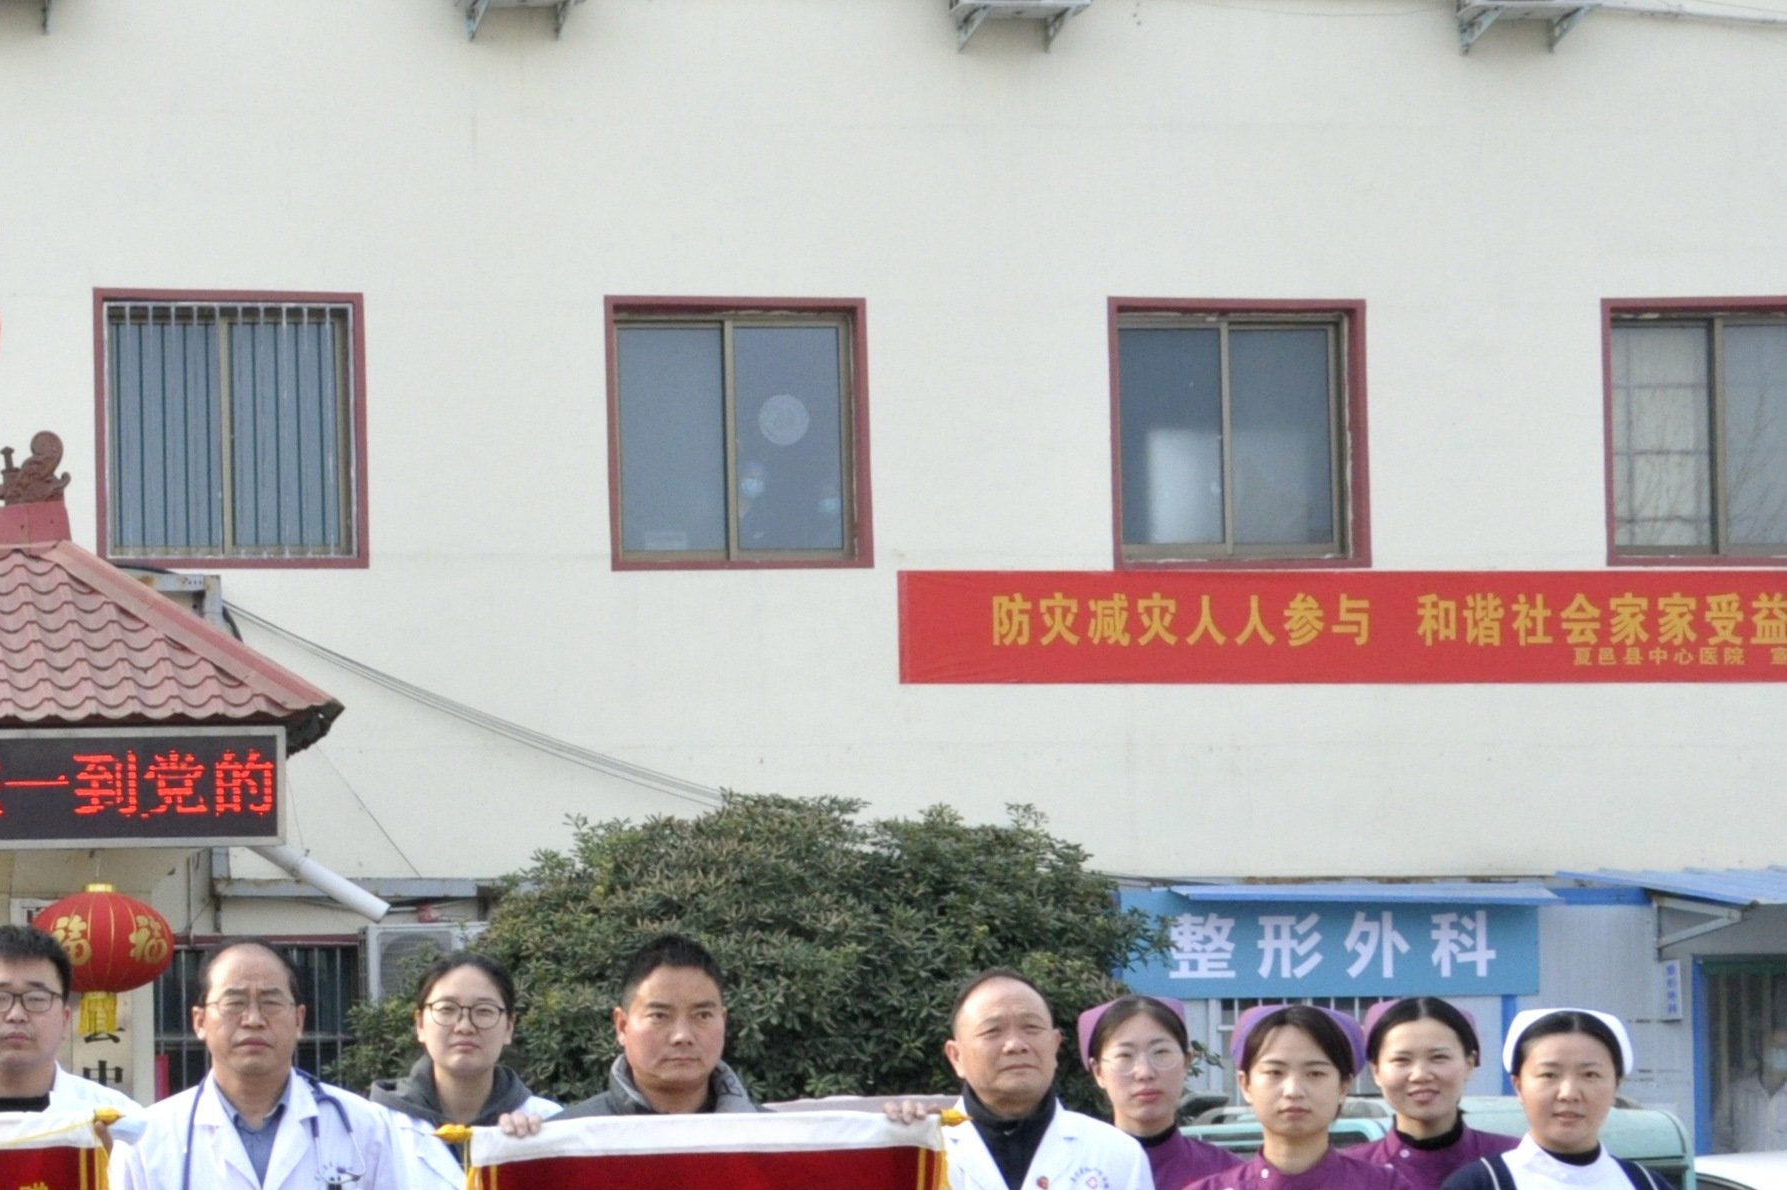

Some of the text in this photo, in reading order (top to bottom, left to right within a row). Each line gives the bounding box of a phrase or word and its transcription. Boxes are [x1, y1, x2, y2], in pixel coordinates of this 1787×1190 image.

[992, 592, 1372, 646] 防灾减灾人人参与
[1417, 592, 1787, 648] 和谐社会家家受益
[1573, 646, 1746, 666] 夏邑县中心医院
[1168, 911, 1497, 979] 整形外科
